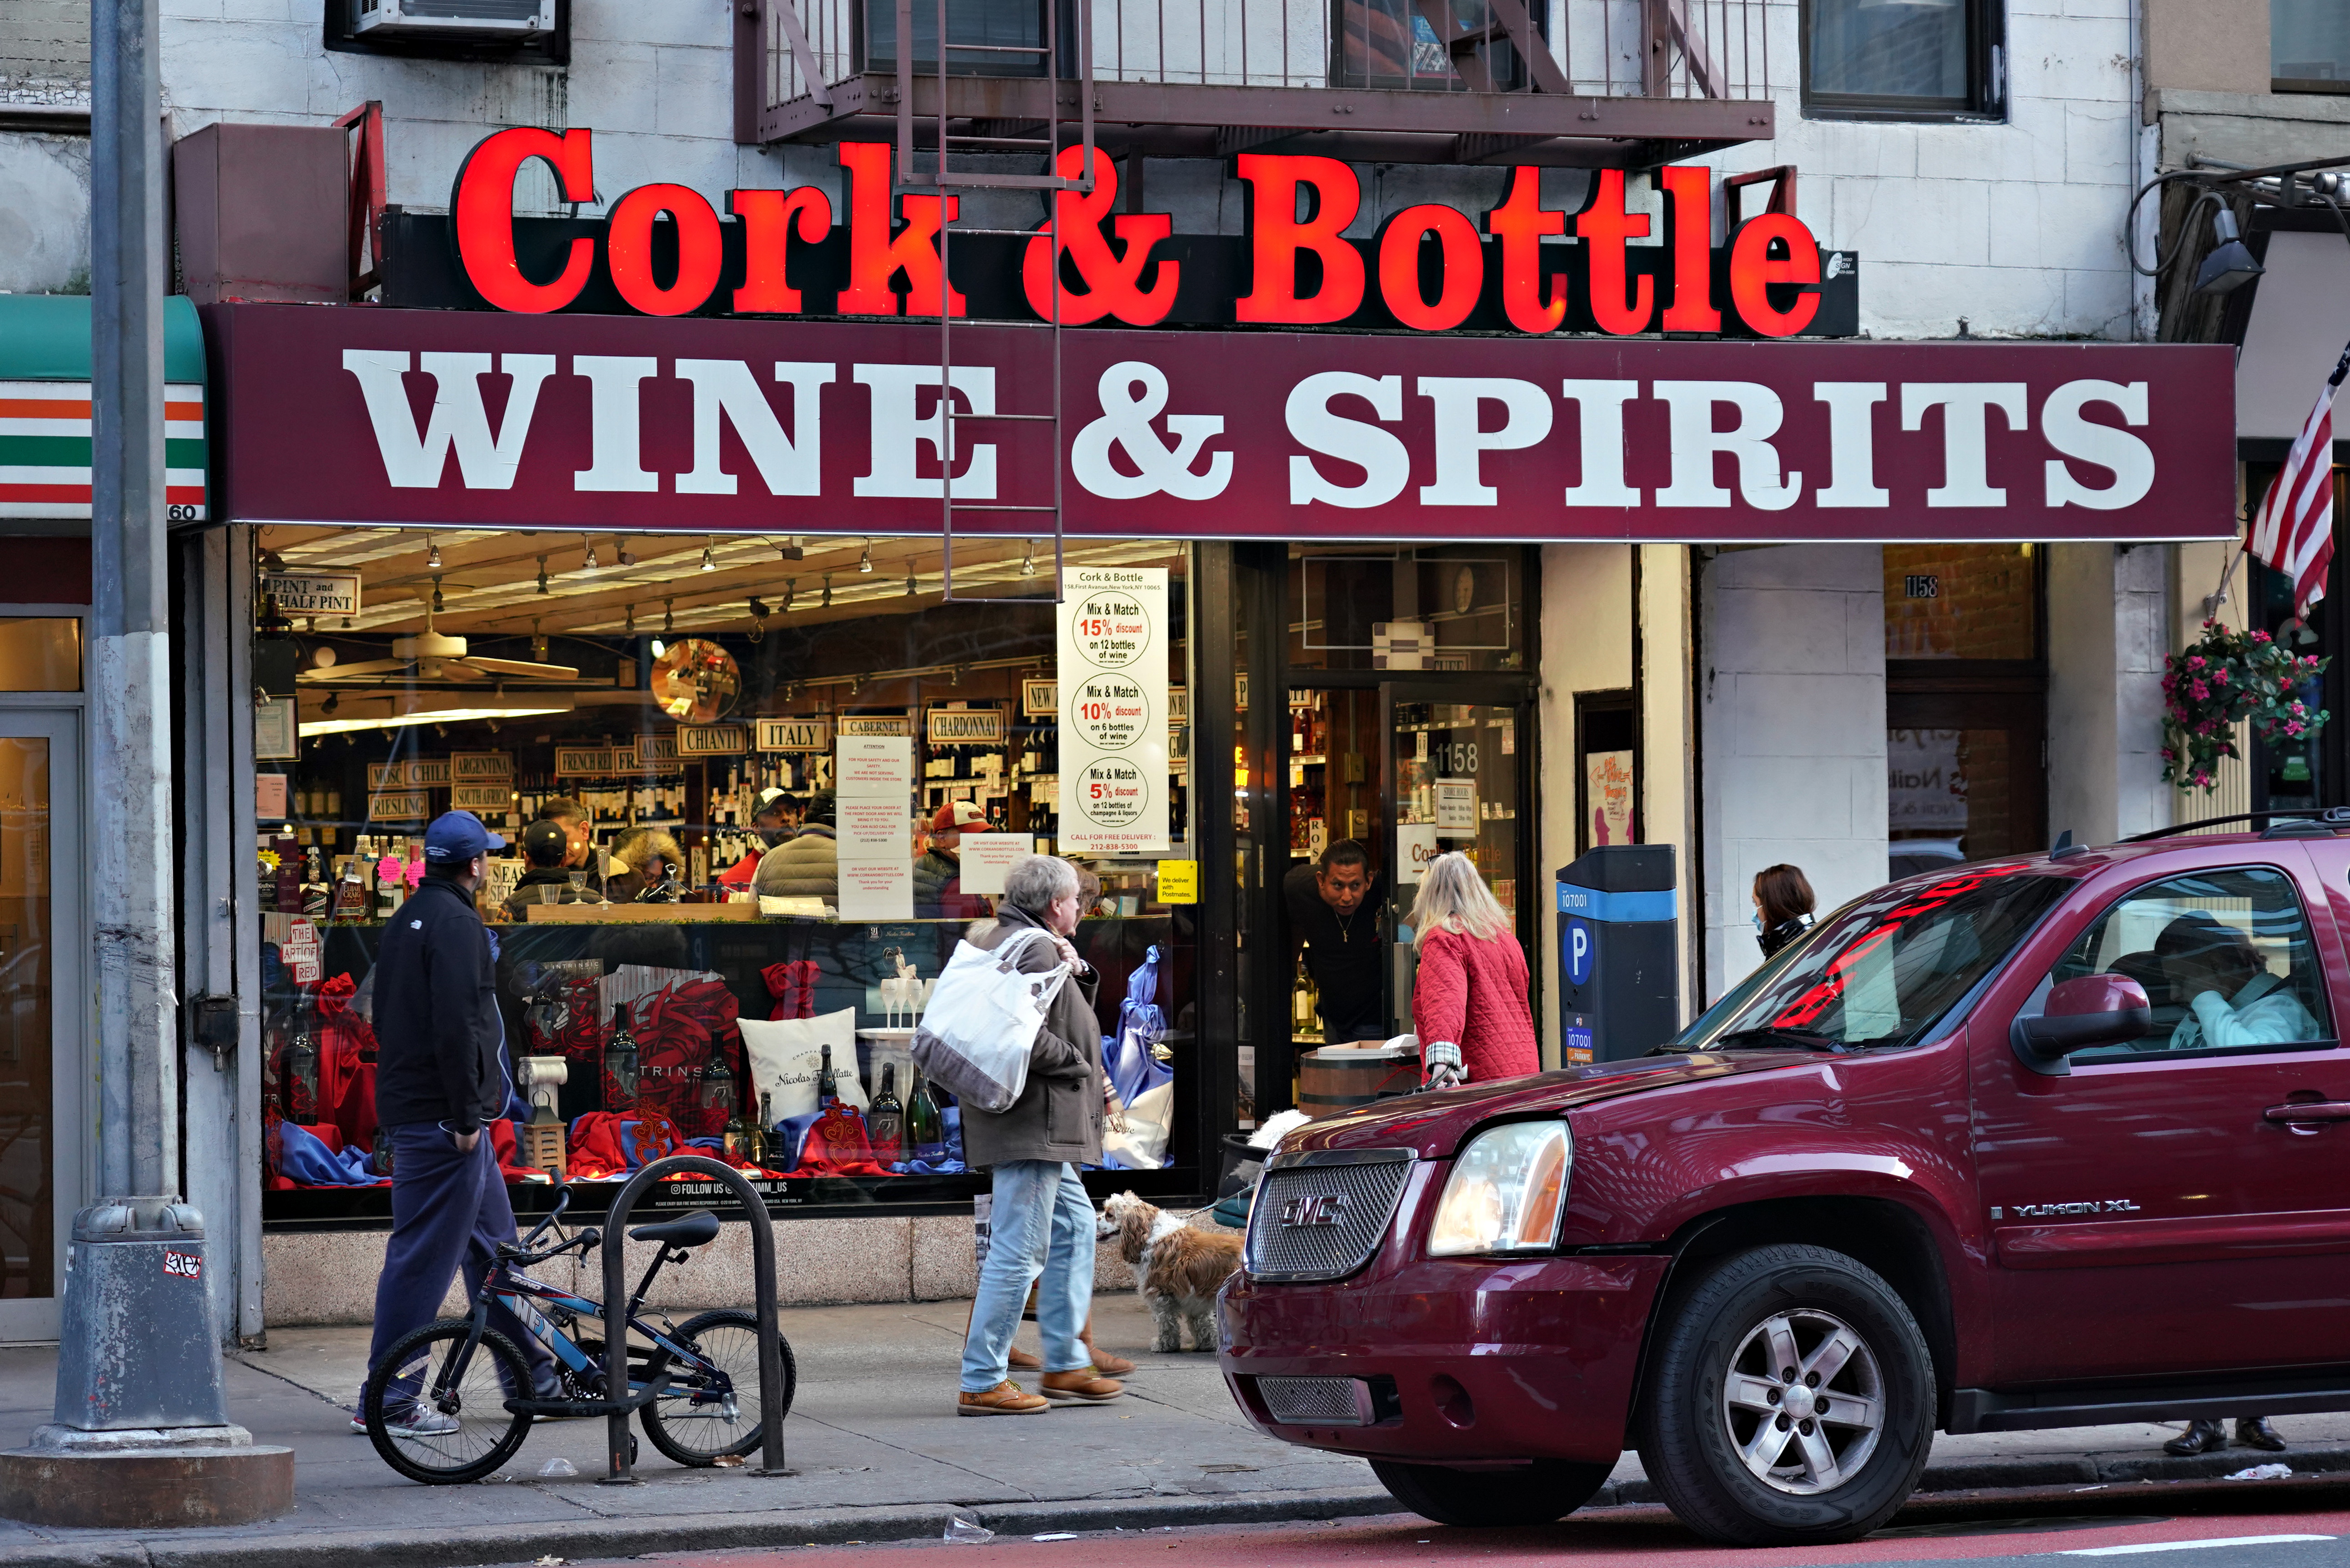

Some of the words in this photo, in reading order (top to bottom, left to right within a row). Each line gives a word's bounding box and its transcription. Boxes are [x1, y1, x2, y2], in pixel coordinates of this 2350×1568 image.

[452, 126, 967, 317] Cork
[1022, 143, 1180, 327] &
[1236, 154, 1821, 337] Bottle
[342, 348, 997, 500] WINE
[1071, 360, 1233, 501] &
[1285, 371, 2155, 511] SPIRITS
[1080, 573, 1101, 582] Cork
[1104, 573, 1111, 582] &
[1114, 573, 1143, 582] Bottle
[273, 579, 310, 594] PINT
[316, 583, 333, 592] and
[1906, 576, 1938, 597] 1158
[280, 594, 316, 608] HALF
[320, 596, 351, 610] PINT
[1087, 603, 1102, 615] Mix
[1105, 603, 1111, 615] &
[1114, 603, 1139, 615] Match
[1080, 619, 1112, 636] 15%
[1116, 623, 1142, 633] discount
[1100, 639, 1109, 649] 12
[1111, 639, 1135, 650] bottles
[1109, 651, 1127, 659] wine
[1031, 687, 1051, 708] NEW
[1087, 685, 1102, 698] Mix
[1105, 685, 1111, 698] &
[1114, 685, 1138, 698] Match
[1080, 702, 1111, 720] 10%
[1115, 706, 1141, 716] discount
[850, 721, 901, 732] CABERNET
[934, 716, 997, 737] CHARDONNAY
[687, 729, 737, 750] CHIANTI
[769, 725, 818, 745] ITALY
[643, 740, 677, 758] AUSTRA
[562, 753, 595, 770] FRENCH
[1436, 743, 1478, 772] 1158
[412, 764, 451, 781] CHILE
[457, 758, 507, 774] ARGENTINA
[1090, 768, 1104, 779] Mix
[1106, 768, 1112, 779] &
[1115, 769, 1136, 780] Match
[374, 768, 402, 784] MOSC
[457, 788, 482, 805] SOUTH
[482, 788, 507, 804] AFRICA
[1090, 783, 1113, 799] 5%
[1115, 786, 1138, 796] discount
[374, 797, 423, 815] RIESLING
[1311, 820, 1320, 860] ROS
[1563, 894, 1587, 907] 107001
[292, 928, 310, 940] THE
[284, 947, 301, 960] ART
[304, 947, 316, 959] OF
[1572, 928, 1587, 975] P
[299, 966, 317, 979] RED
[552, 961, 599, 970] INTRINSIC
[1568, 1033, 1591, 1048] 107001
[1574, 1052, 1591, 1061] PARKNYC
[640, 1065, 702, 1077] TRINS
[775, 1072, 811, 1087] Nicolas
[682, 1183, 712, 1195] FOLLOW
[713, 1183, 723, 1194] US
[1281, 1194, 1347, 1227] GMC
[2011, 1201, 2100, 1217] YUKON
[2104, 1199, 2141, 1212] XL
[509, 1276, 542, 1291] DYNO
